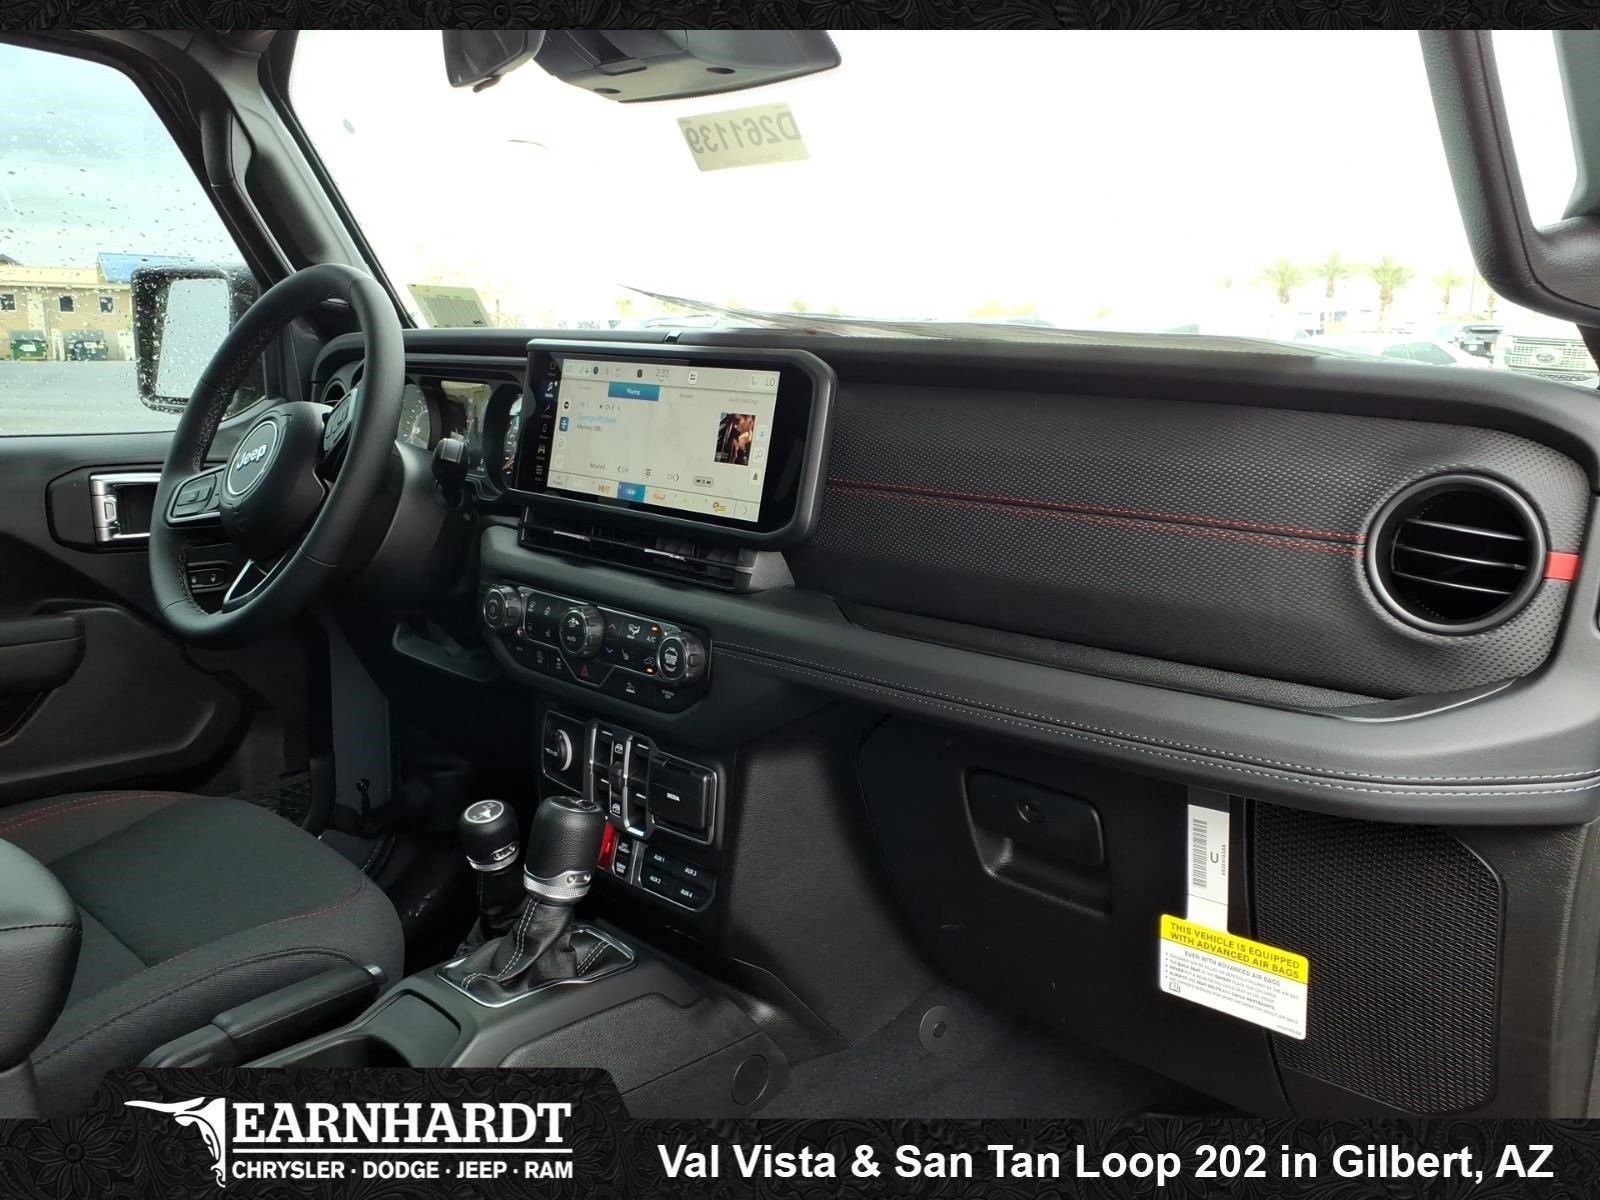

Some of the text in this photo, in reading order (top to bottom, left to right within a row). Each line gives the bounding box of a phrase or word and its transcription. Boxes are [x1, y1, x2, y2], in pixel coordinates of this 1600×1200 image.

[236, 445, 267, 470] Jeep
[1170, 922, 1299, 969] THIS VEHICLE IS EQUIPPED
[1170, 932, 1193, 944] WITH
[1197, 940, 1249, 962] ADVANCED
[1254, 958, 1268, 969] AIR
[1272, 963, 1299, 978] BAGS
[1185, 951, 1199, 959] EVEN
[1201, 956, 1216, 965] WITH
[1217, 961, 1249, 976] ADVANCED
[1264, 976, 1280, 986] BAGS
